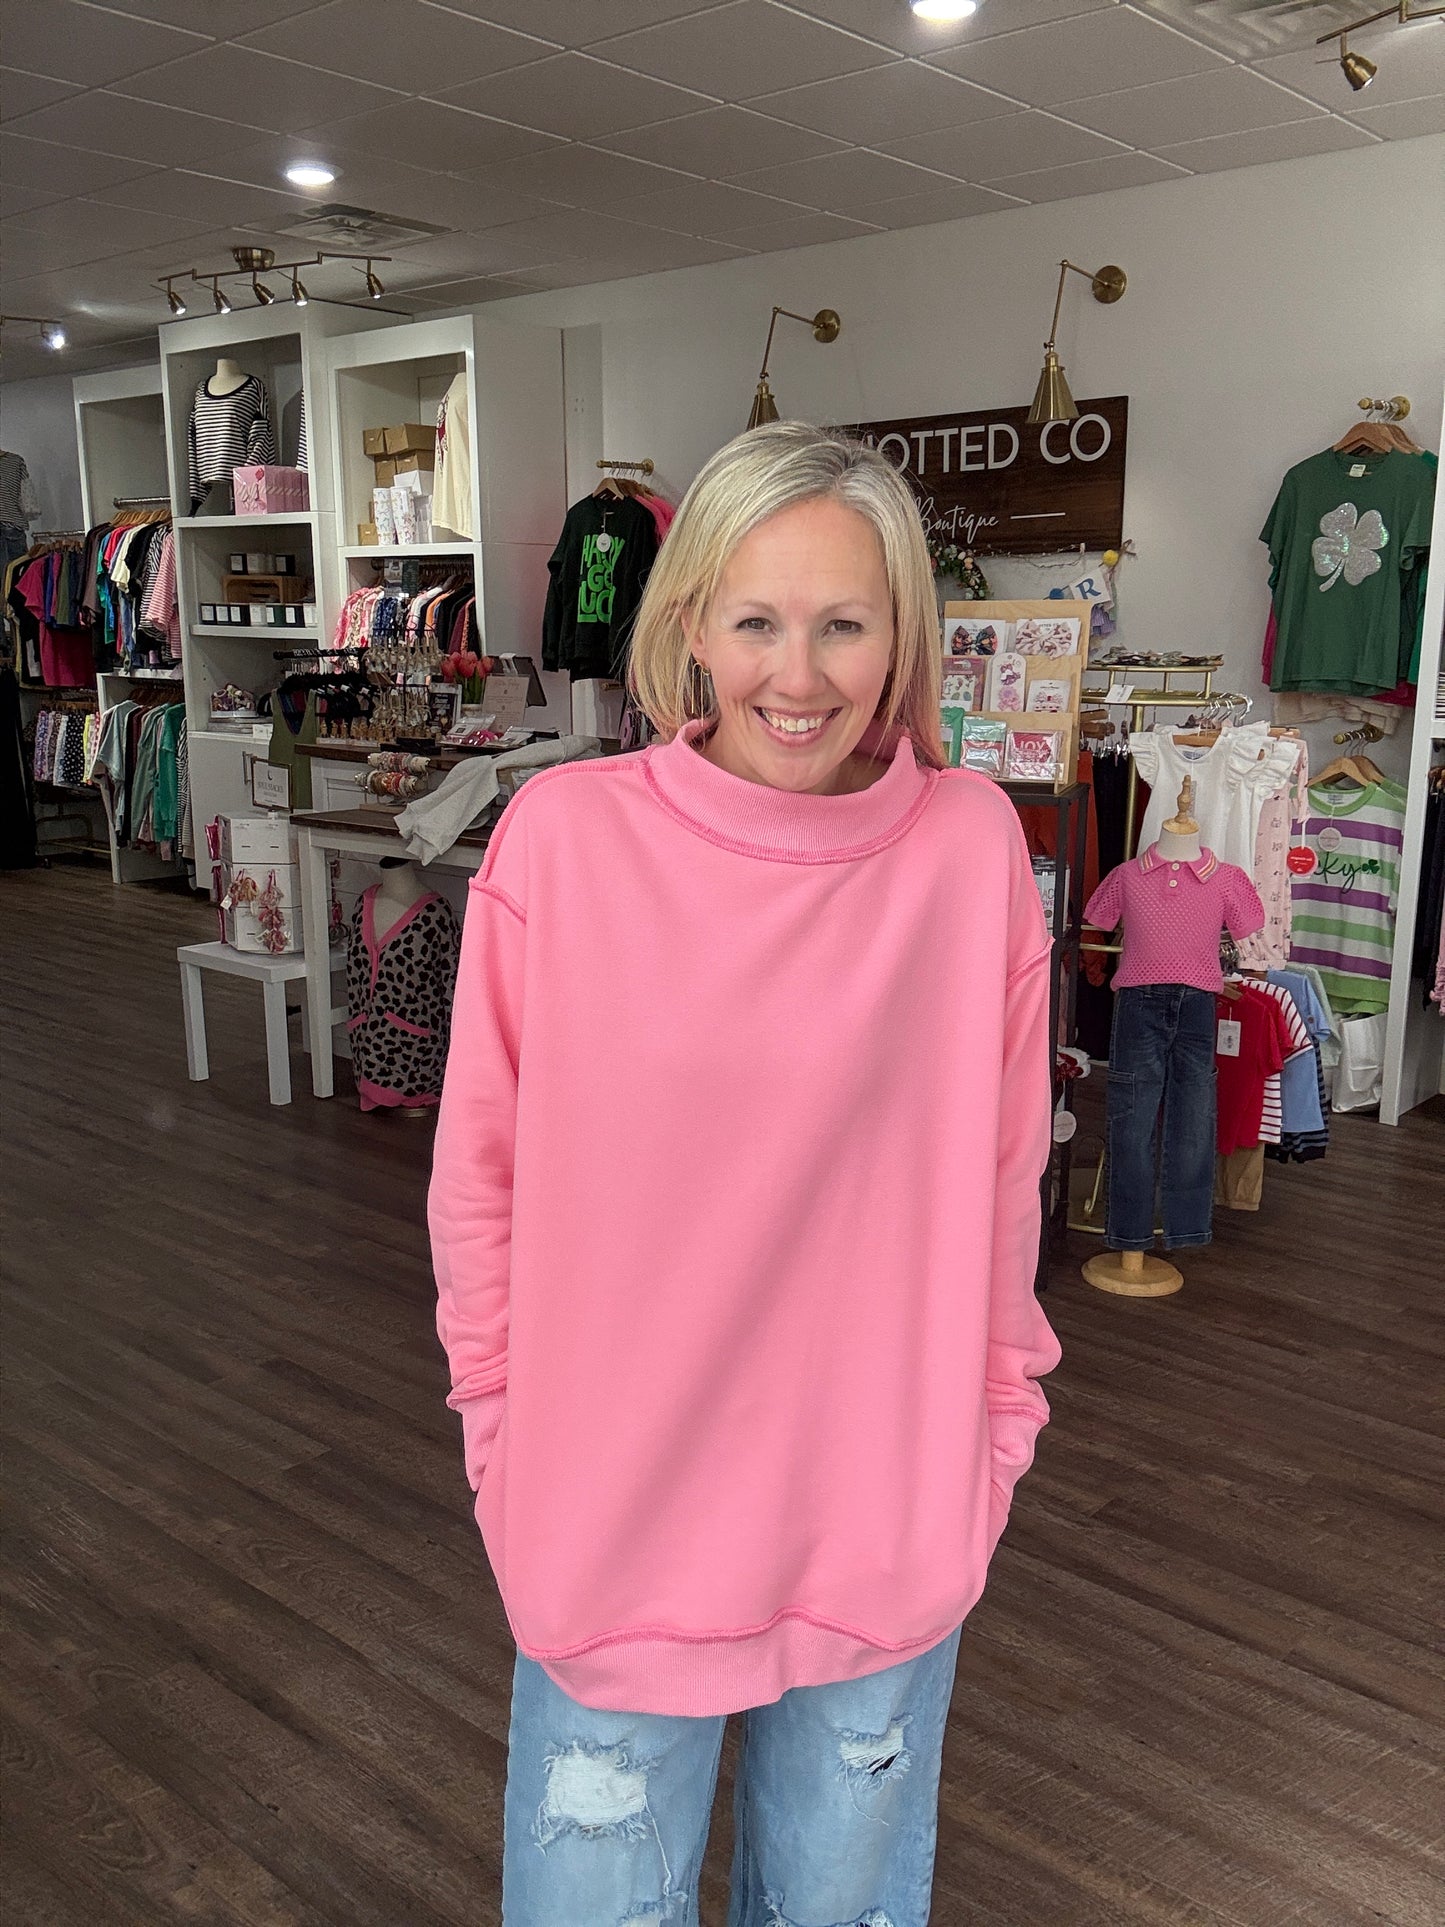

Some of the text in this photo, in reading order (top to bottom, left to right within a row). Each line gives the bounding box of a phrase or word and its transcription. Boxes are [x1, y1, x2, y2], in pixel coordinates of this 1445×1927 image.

[867, 413, 1112, 475] OTTED CO
[912, 496, 998, 544] Boutique
[580, 534, 625, 574] HAPY
[1076, 577, 1101, 600] R
